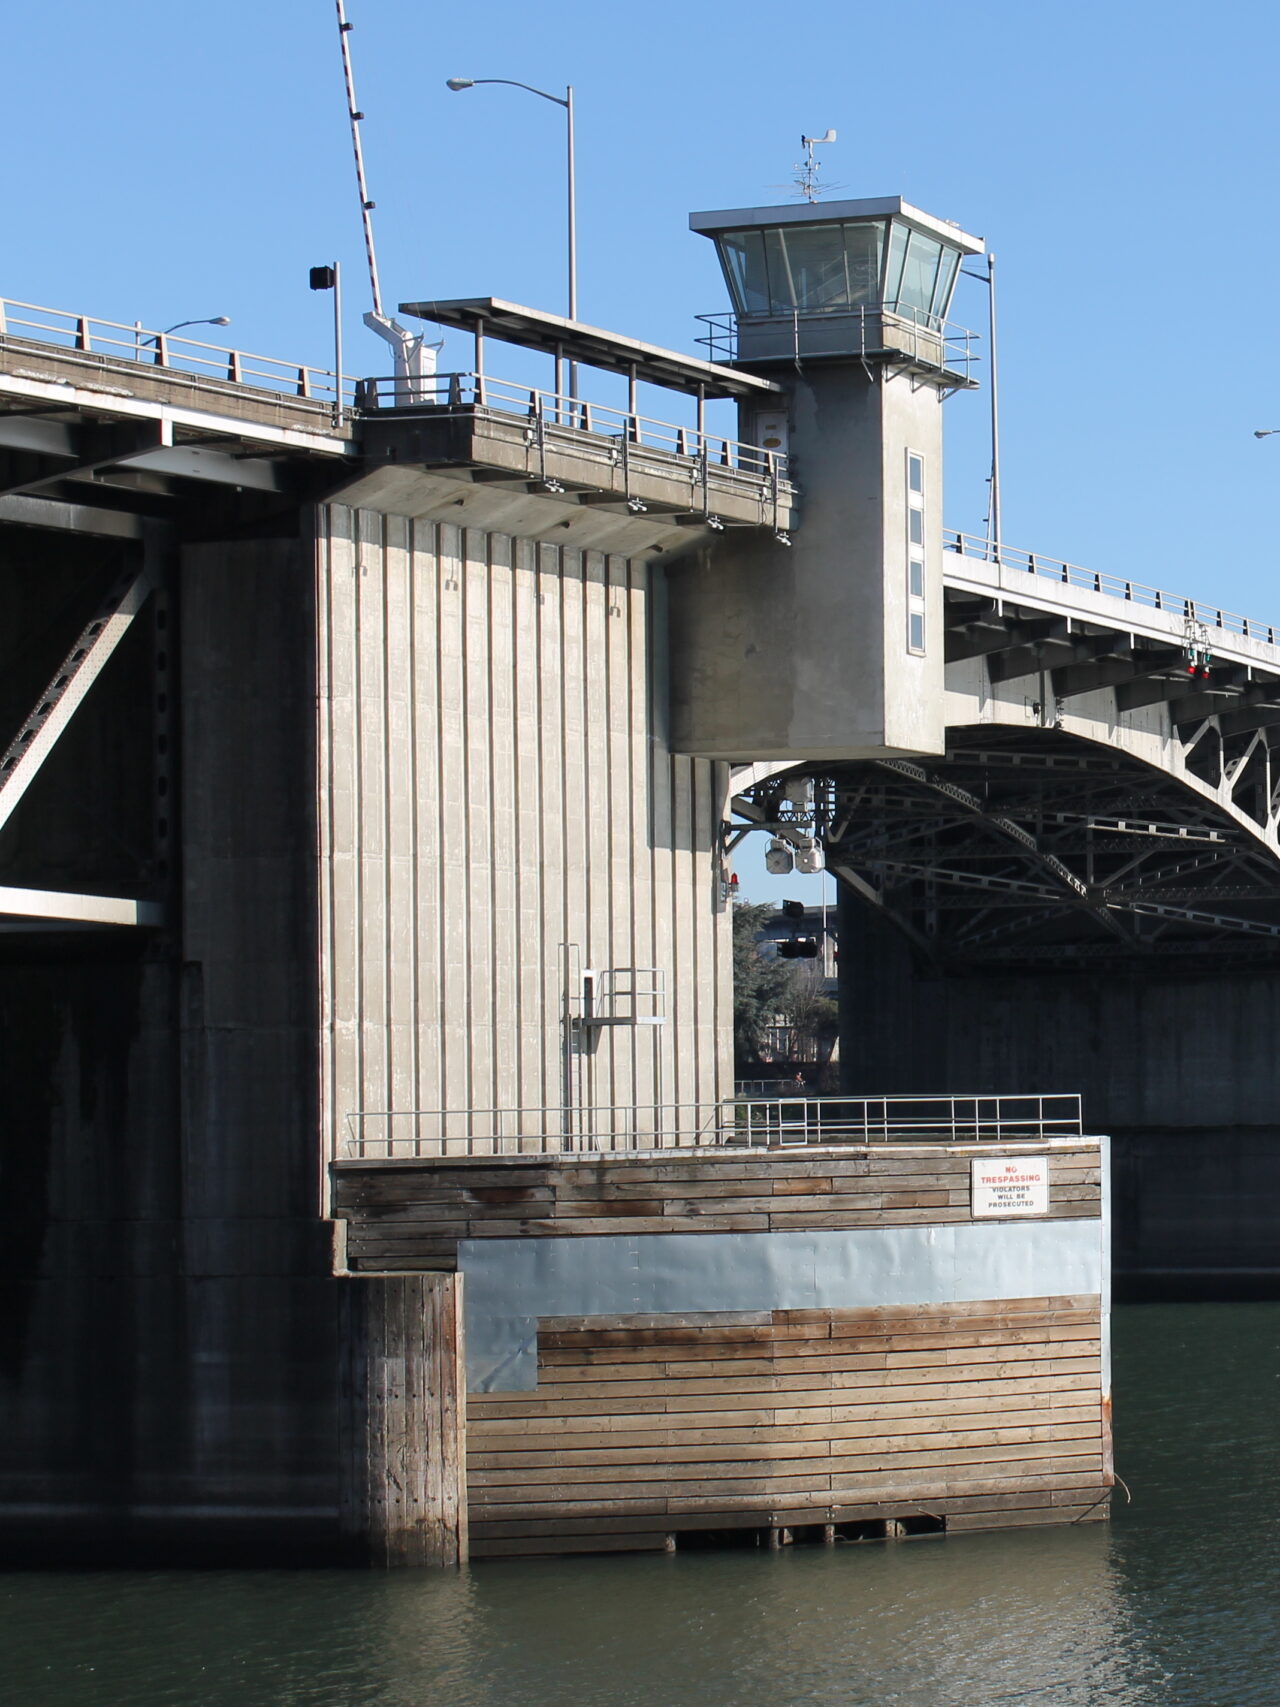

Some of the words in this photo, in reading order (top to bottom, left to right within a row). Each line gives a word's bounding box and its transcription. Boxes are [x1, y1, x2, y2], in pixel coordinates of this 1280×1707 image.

[981, 1174, 1041, 1184] TRESPASSING
[992, 1185, 1030, 1193] VIOLATORS
[988, 1200, 1034, 1208] PROSECUTED
